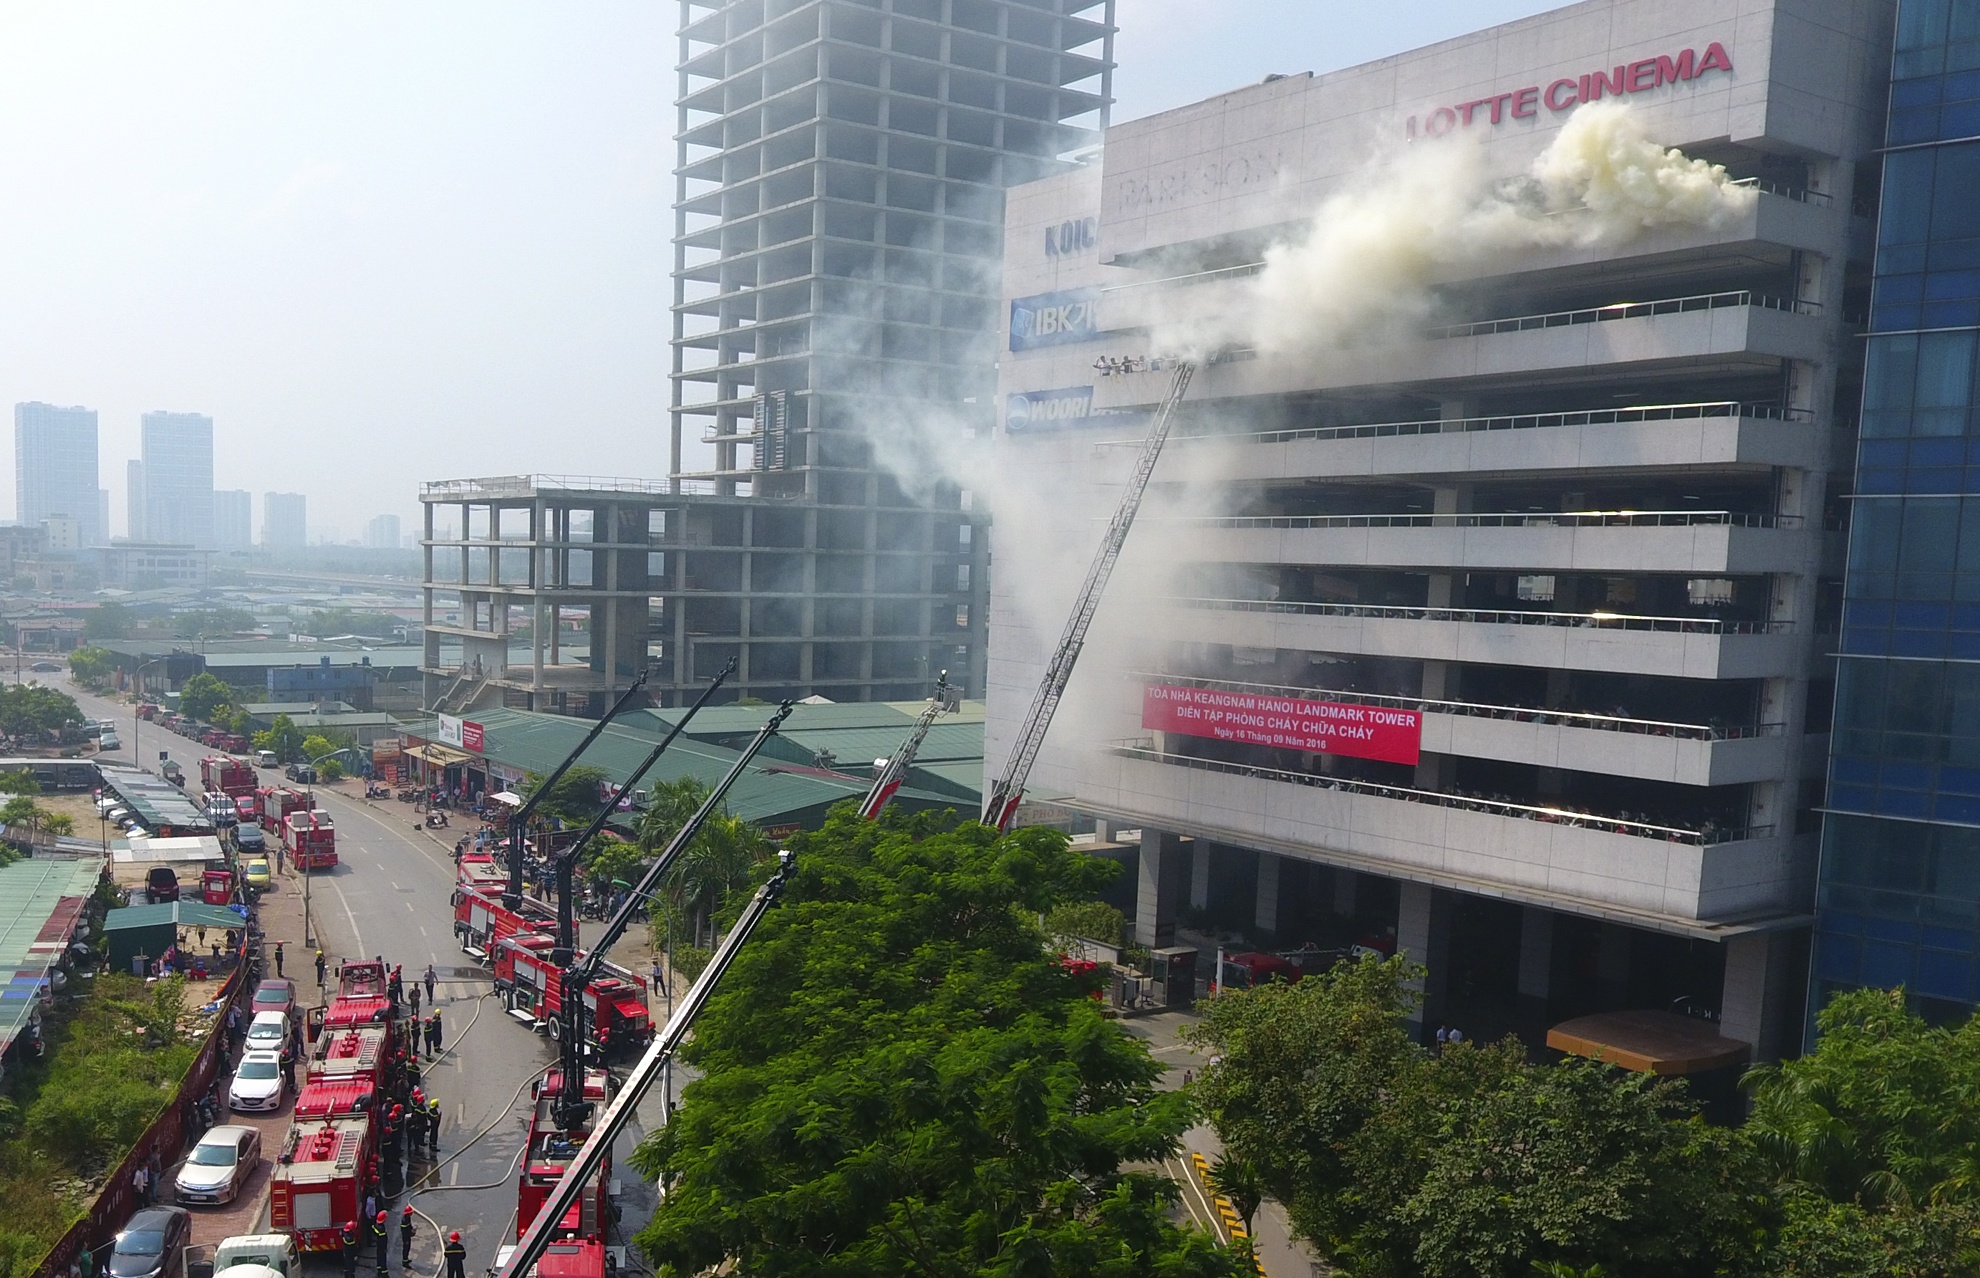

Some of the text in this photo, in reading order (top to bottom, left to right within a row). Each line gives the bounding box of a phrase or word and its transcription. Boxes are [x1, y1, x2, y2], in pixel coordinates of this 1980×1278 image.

[1543, 41, 1733, 111] CINEMA
[1045, 216, 1100, 255] KOIC
[1030, 396, 1090, 422] WOORI
[1170, 688, 1192, 702] NHÀ
[1194, 692, 1254, 709] KEANGNAM
[1258, 699, 1294, 714] HANOI
[1297, 703, 1365, 721] LANDMARK
[1368, 711, 1415, 727] TOWER
[1203, 709, 1224, 723] TẬP
[1226, 711, 1265, 727] PHÒNG
[1267, 716, 1299, 732] CHÁY
[1302, 720, 1336, 736] CHỮA
[1339, 725, 1374, 740] CHÁY
[1214, 726, 1234, 739] Ngày
[1236, 729, 1245, 739] 16
[1247, 731, 1272, 744] Tháng
[1273, 733, 1284, 744] 09
[1306, 738, 1327, 749] 2016
